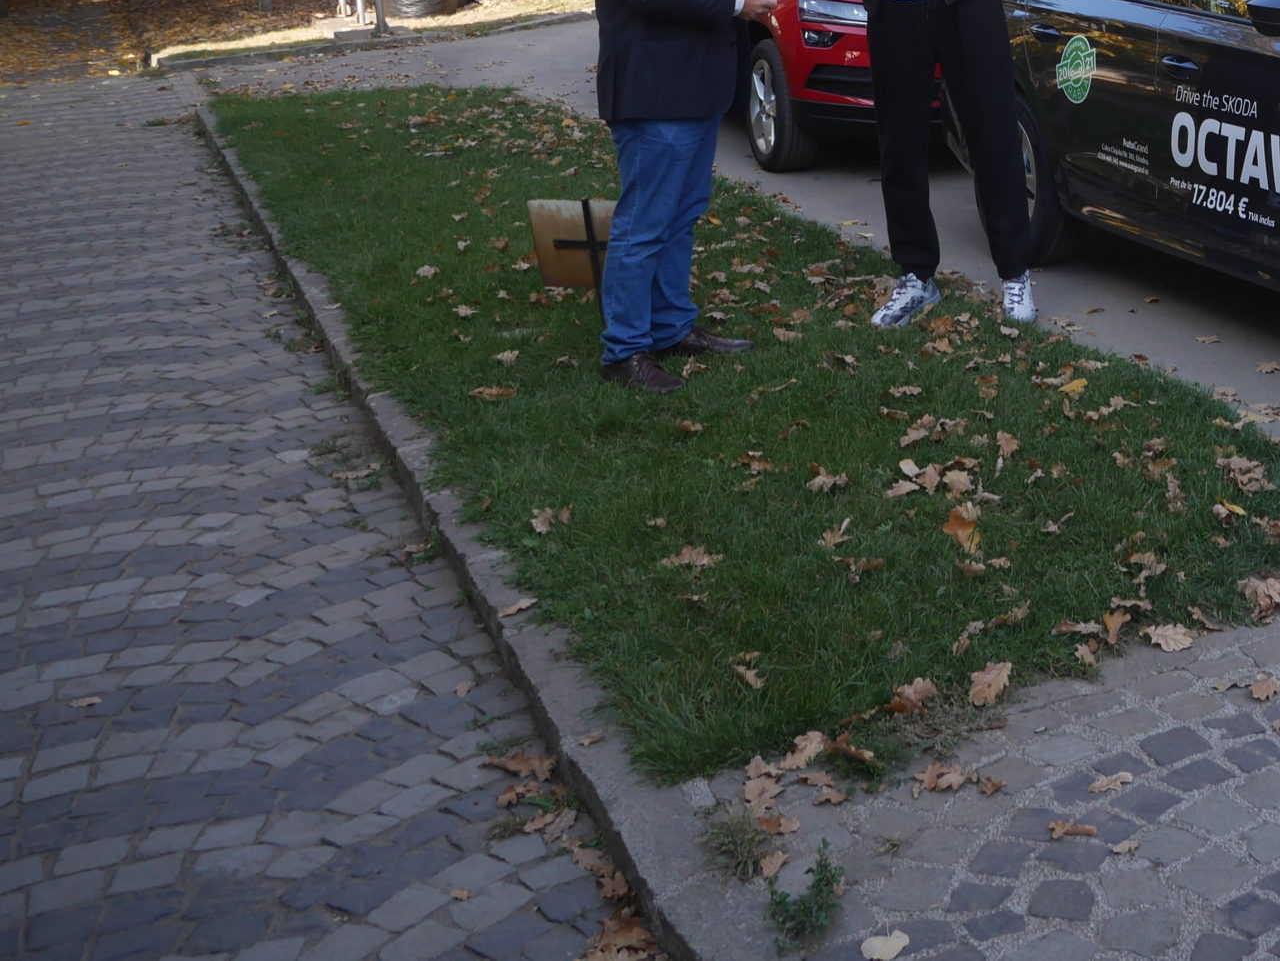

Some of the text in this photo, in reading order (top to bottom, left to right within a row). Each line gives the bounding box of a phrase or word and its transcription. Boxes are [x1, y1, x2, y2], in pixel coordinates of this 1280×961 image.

[1175, 85, 1258, 119] Drive the SKODA
[1192, 183, 1235, 215] 17.804
[1238, 197, 1249, 219] €
[1248, 211, 1259, 223] TVA
[1259, 214, 1275, 228] inclus
